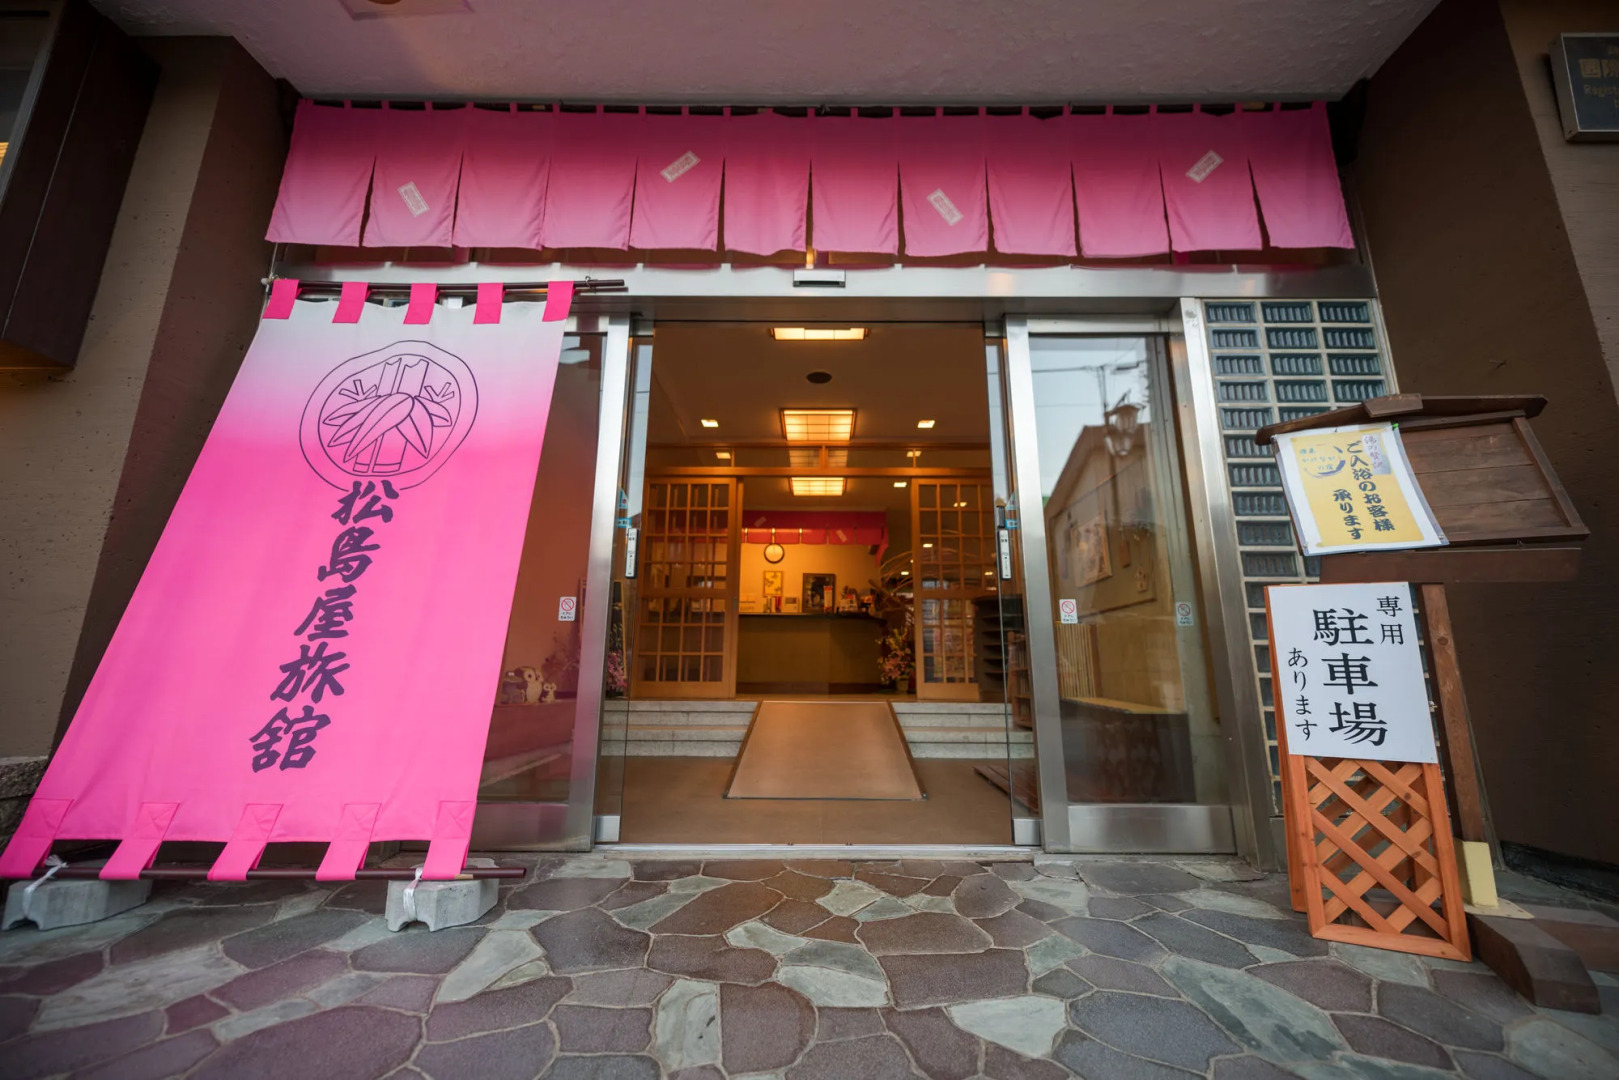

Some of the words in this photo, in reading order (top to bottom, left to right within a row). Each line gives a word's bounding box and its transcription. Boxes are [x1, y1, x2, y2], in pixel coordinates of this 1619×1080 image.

[1333, 488, 1364, 540] 承ります
[1347, 440, 1395, 531] ご入浴のお客様
[249, 479, 400, 773] 松島屋旅館
[1376, 595, 1405, 646] 専用
[1287, 646, 1318, 742] あります
[1312, 607, 1389, 747] 駐車場
